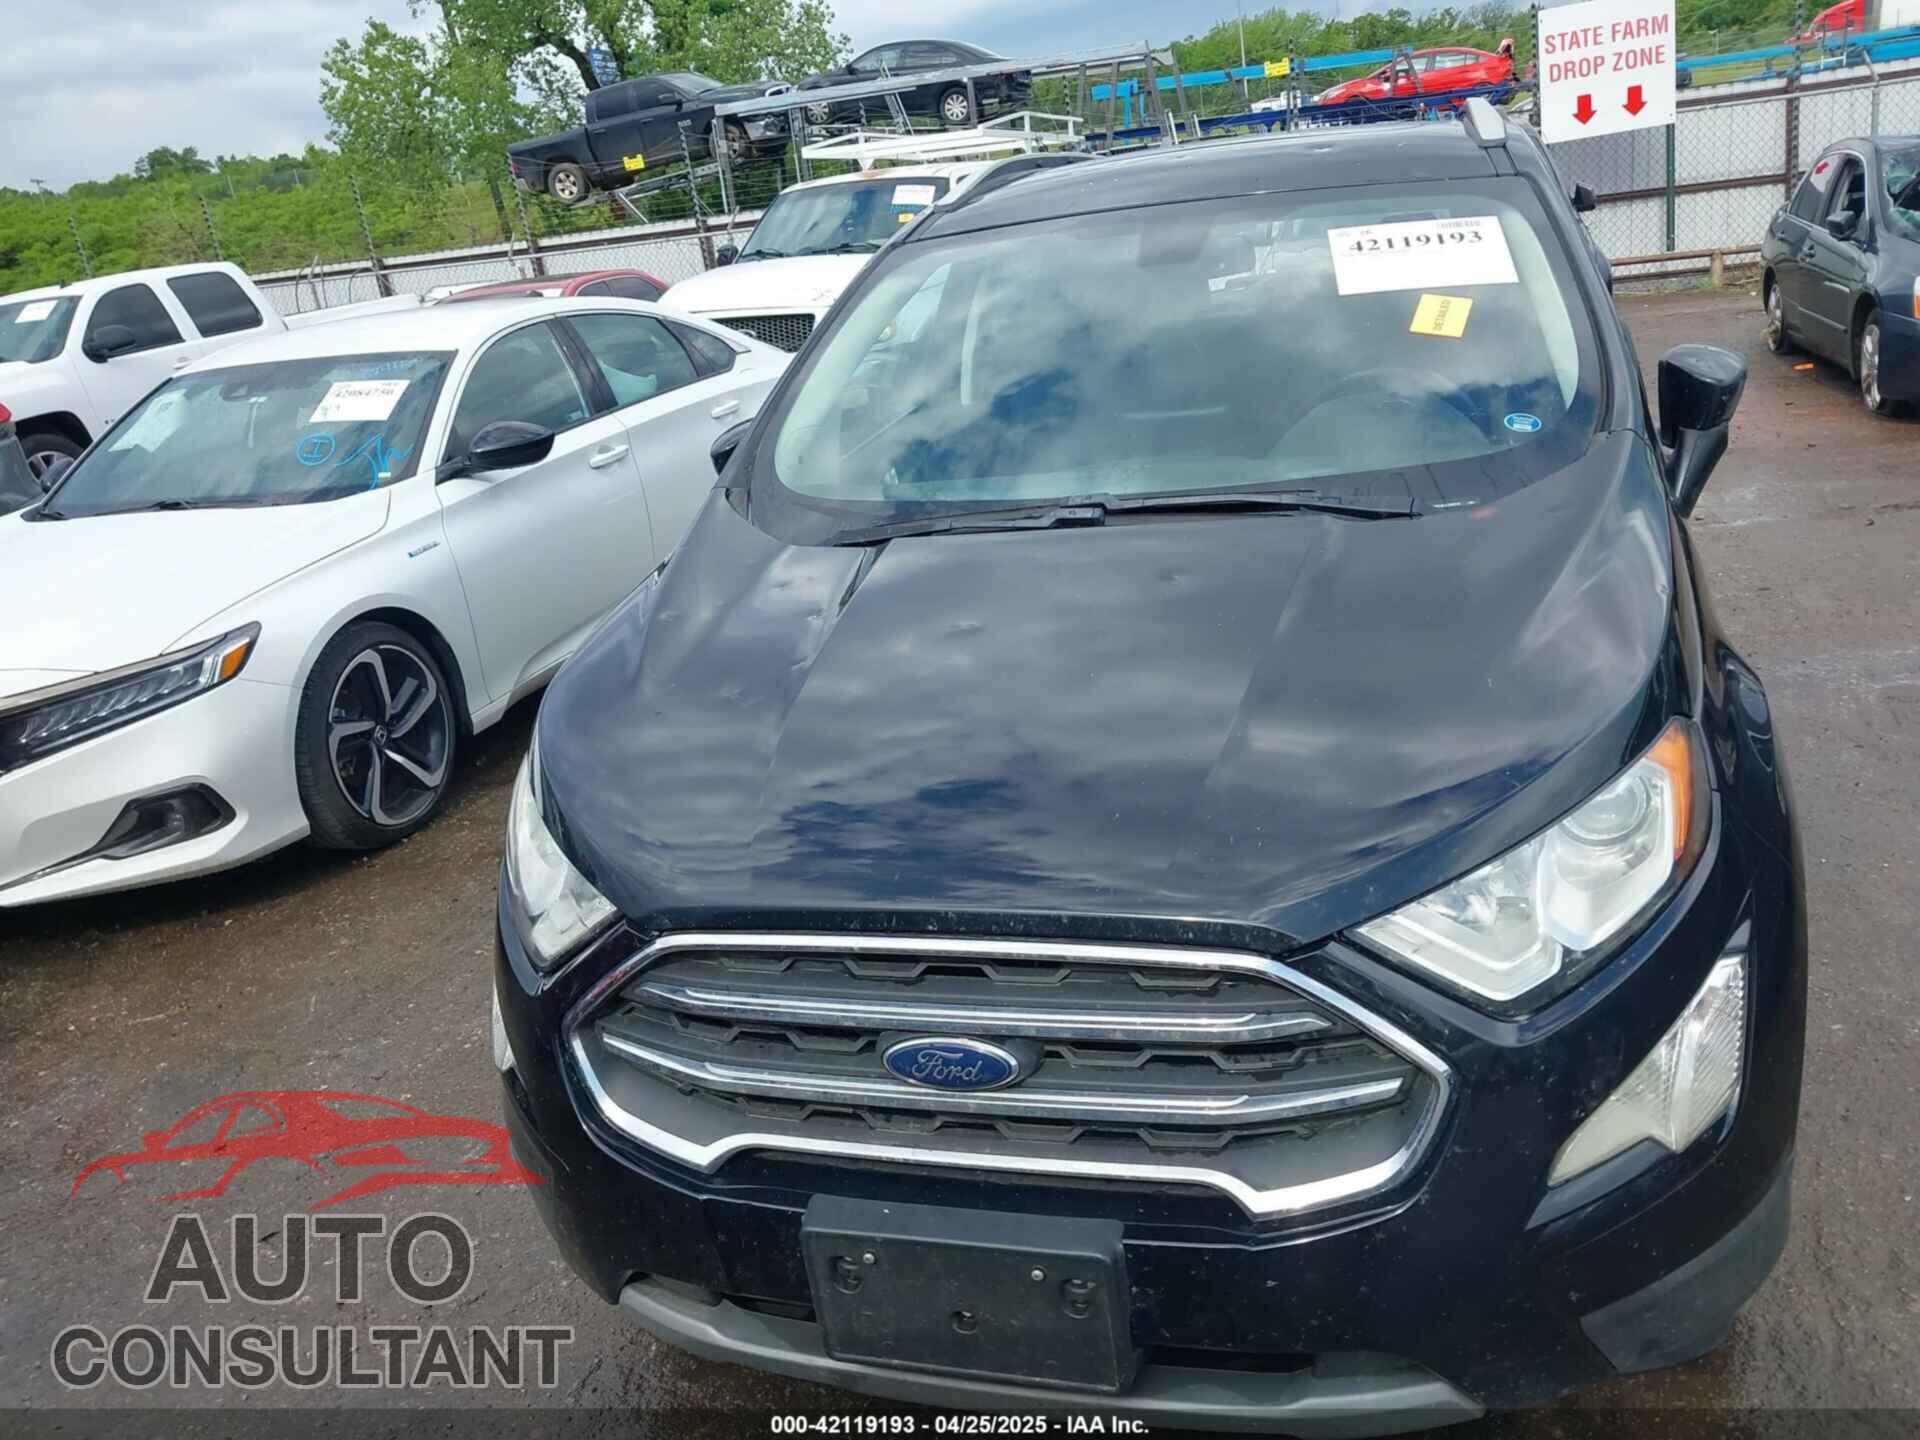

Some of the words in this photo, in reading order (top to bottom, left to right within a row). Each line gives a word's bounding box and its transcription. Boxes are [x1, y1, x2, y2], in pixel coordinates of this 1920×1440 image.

[1544, 26, 1603, 54] STATE
[1611, 14, 1669, 42] FARM
[1549, 55, 1605, 83] DROP
[1612, 44, 1665, 72] ZONE
[1349, 230, 1483, 252] 42119193
[911, 1049, 983, 1081] Ford
